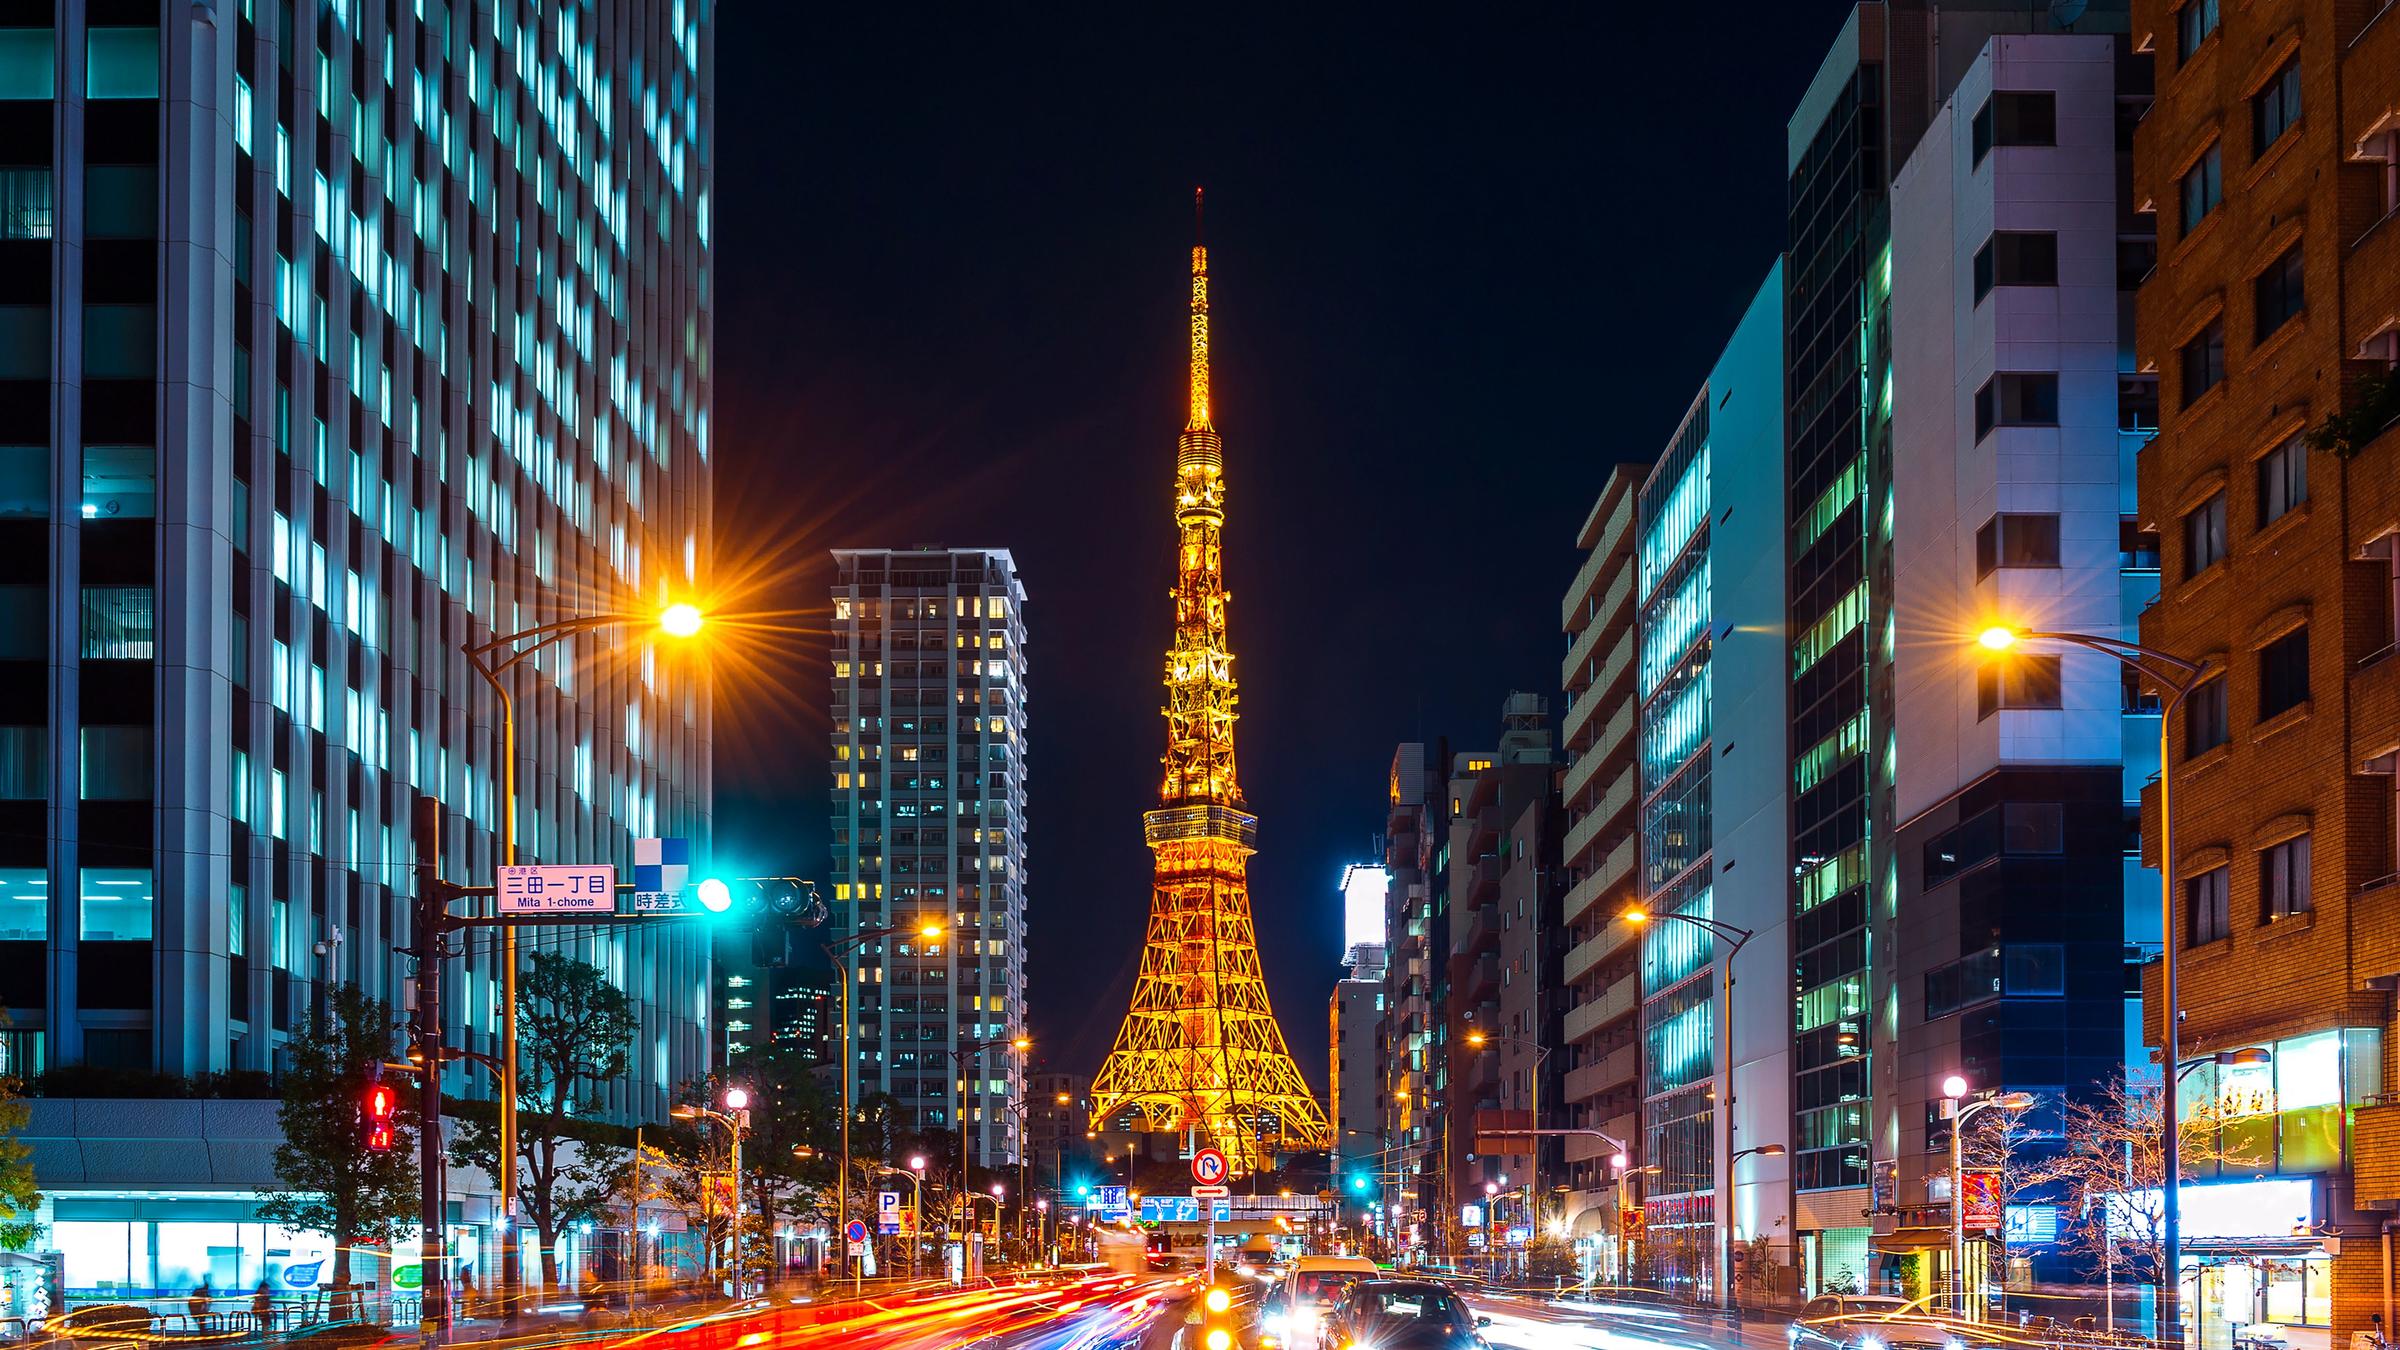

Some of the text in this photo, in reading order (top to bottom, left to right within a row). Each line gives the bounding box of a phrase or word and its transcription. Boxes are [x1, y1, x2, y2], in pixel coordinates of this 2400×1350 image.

[506, 875, 605, 894] 三田一丁目
[517, 897, 595, 908] Mita 1-chome
[636, 893, 688, 909] 時差式
[883, 1194, 896, 1211] P
